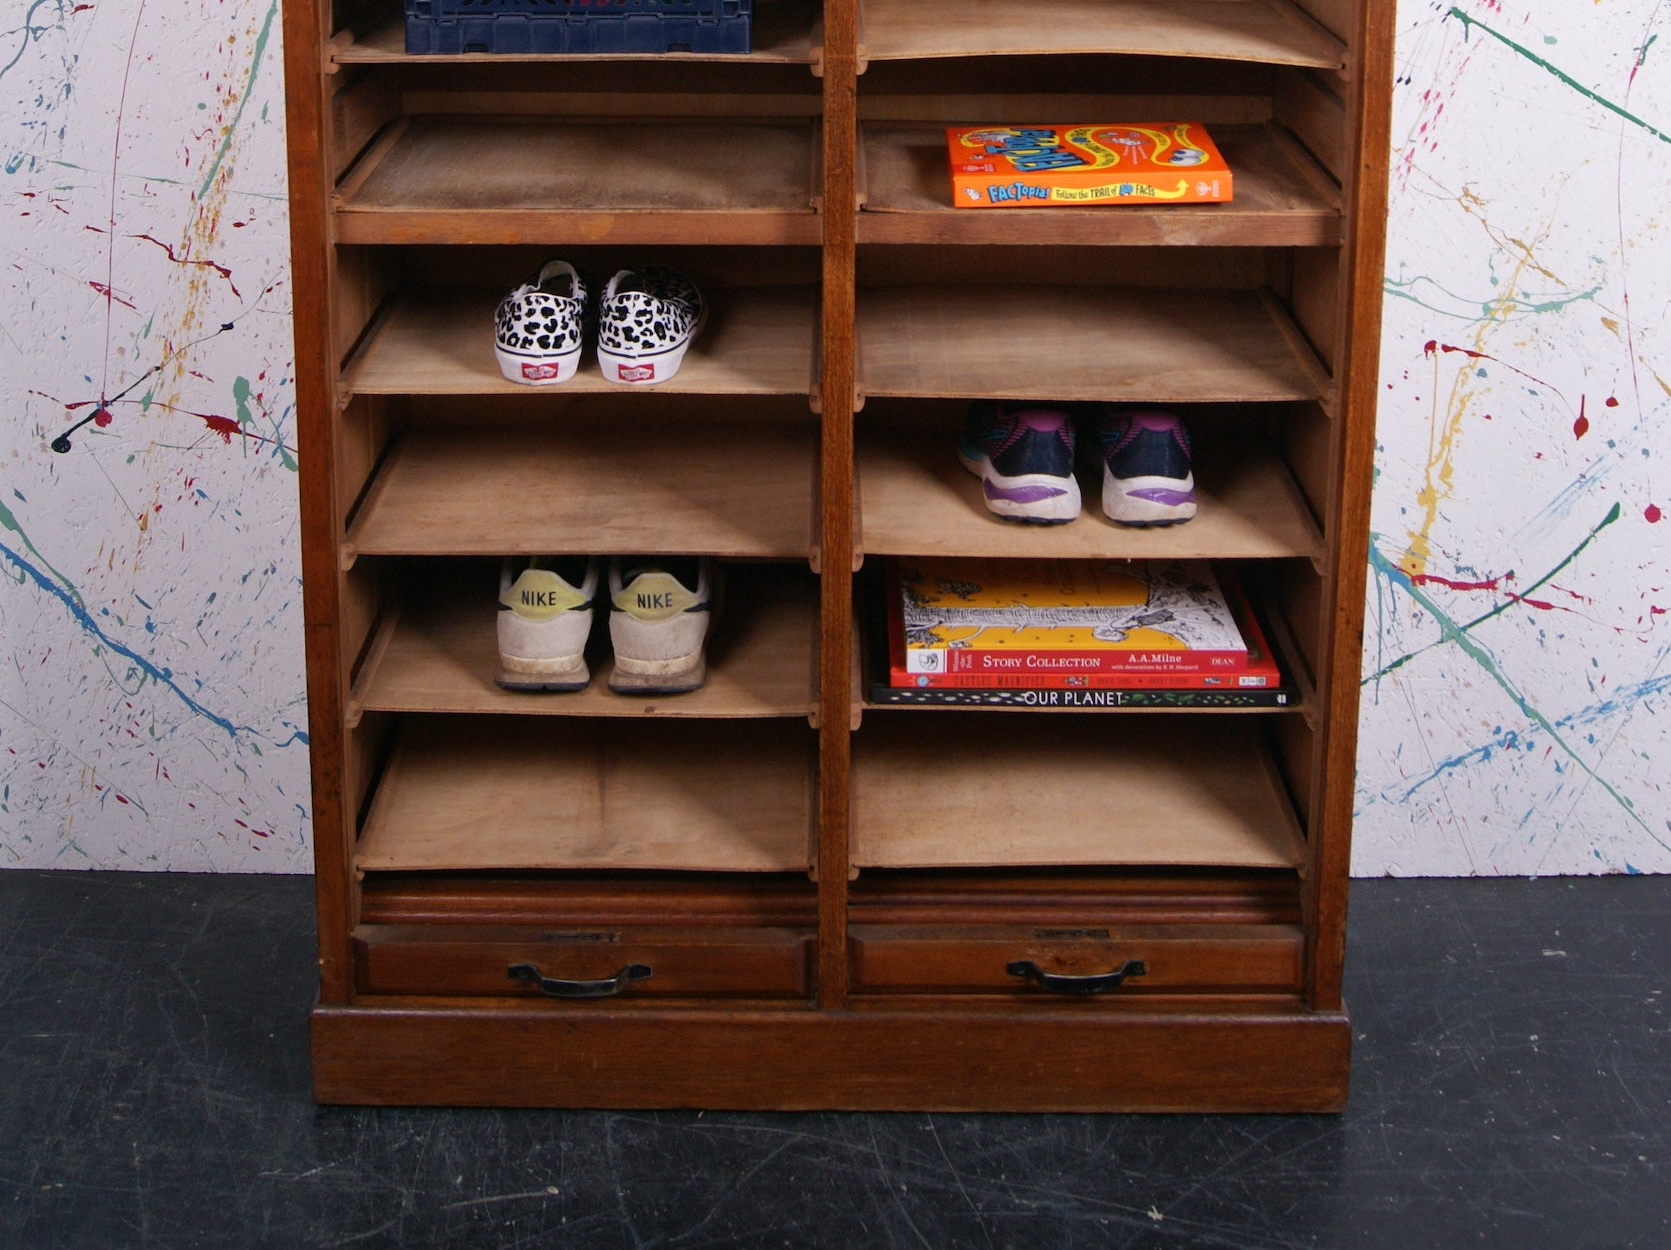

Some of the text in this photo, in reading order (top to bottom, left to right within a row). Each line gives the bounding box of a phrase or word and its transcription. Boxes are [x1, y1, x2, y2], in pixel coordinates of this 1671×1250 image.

[1056, 189, 1078, 199] Follow
[1079, 189, 1088, 199] the
[1090, 187, 1111, 198] TRAIL
[1111, 186, 1118, 196] of
[521, 591, 557, 607] NIKE
[637, 593, 673, 609] NIKE
[983, 654, 1100, 668] STORY COLLECTION
[1211, 657, 1234, 666] DEAN
[1025, 691, 1123, 706] OUR PLANET
